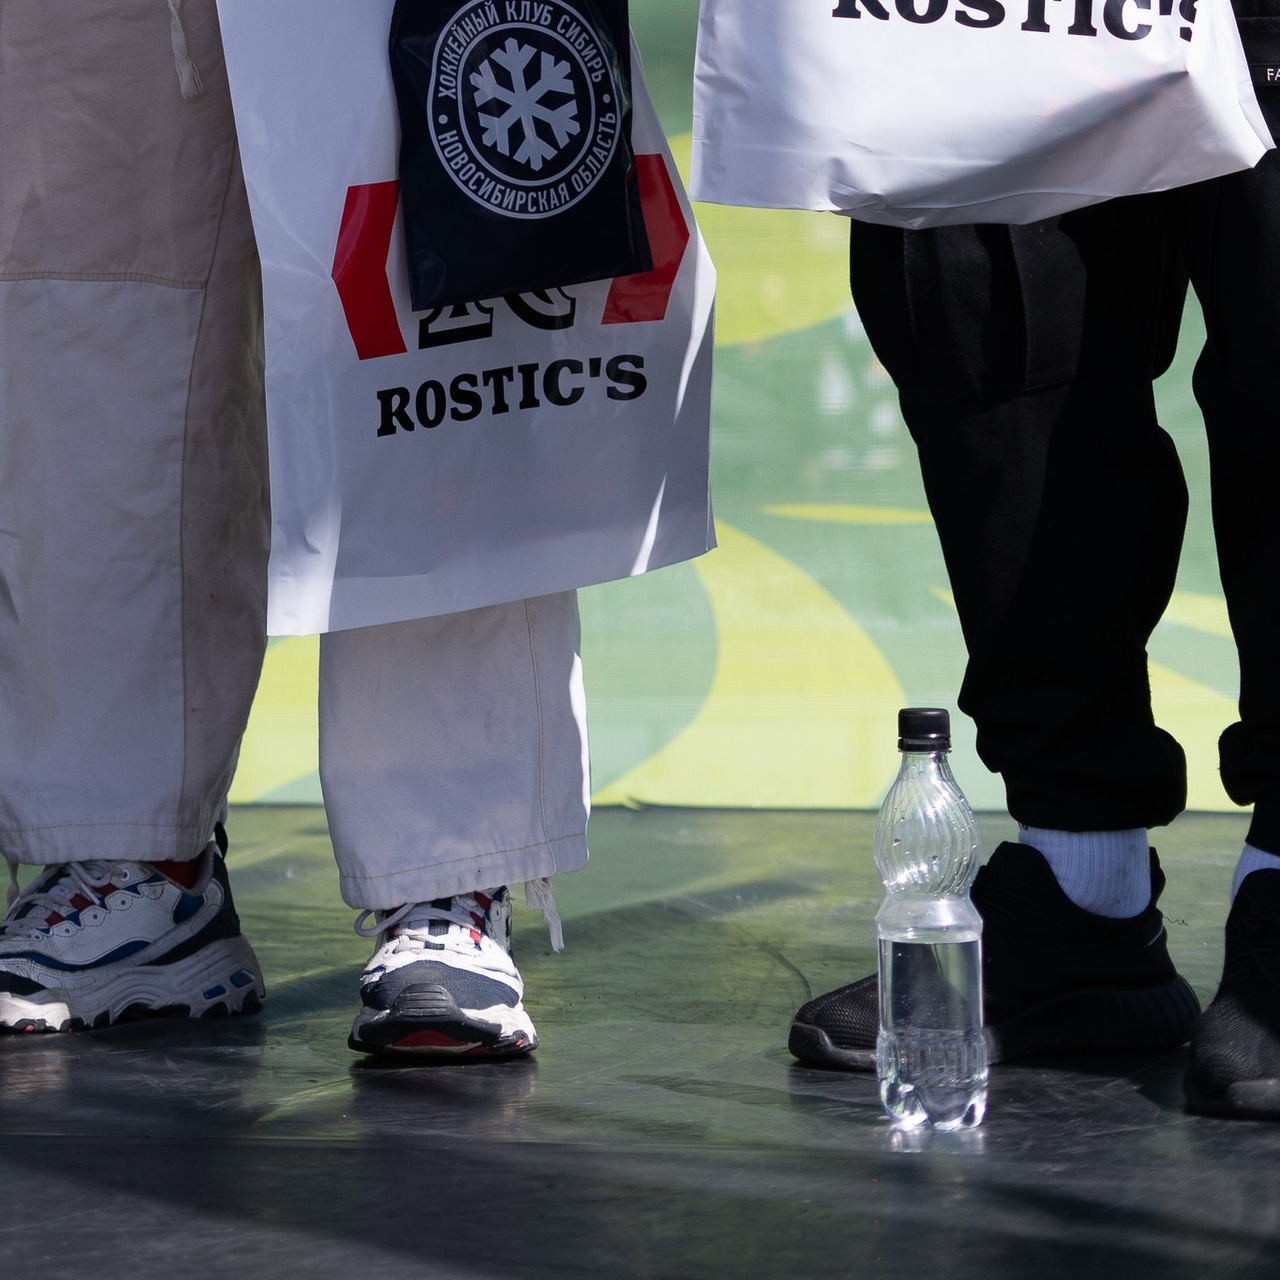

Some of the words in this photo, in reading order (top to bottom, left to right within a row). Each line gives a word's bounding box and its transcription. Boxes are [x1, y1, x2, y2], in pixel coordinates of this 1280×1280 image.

[437, 0, 501, 100] ХОККЕЙНЫЙ
[505, 0, 555, 22] КЛУБ
[556, 14, 607, 84] СИБИРЬ
[437, 129, 571, 214] НОВОСИБИРСКАЯ
[570, 112, 617, 194] ОБЛАСТЬ
[376, 354, 649, 438] ROSTIC'S
